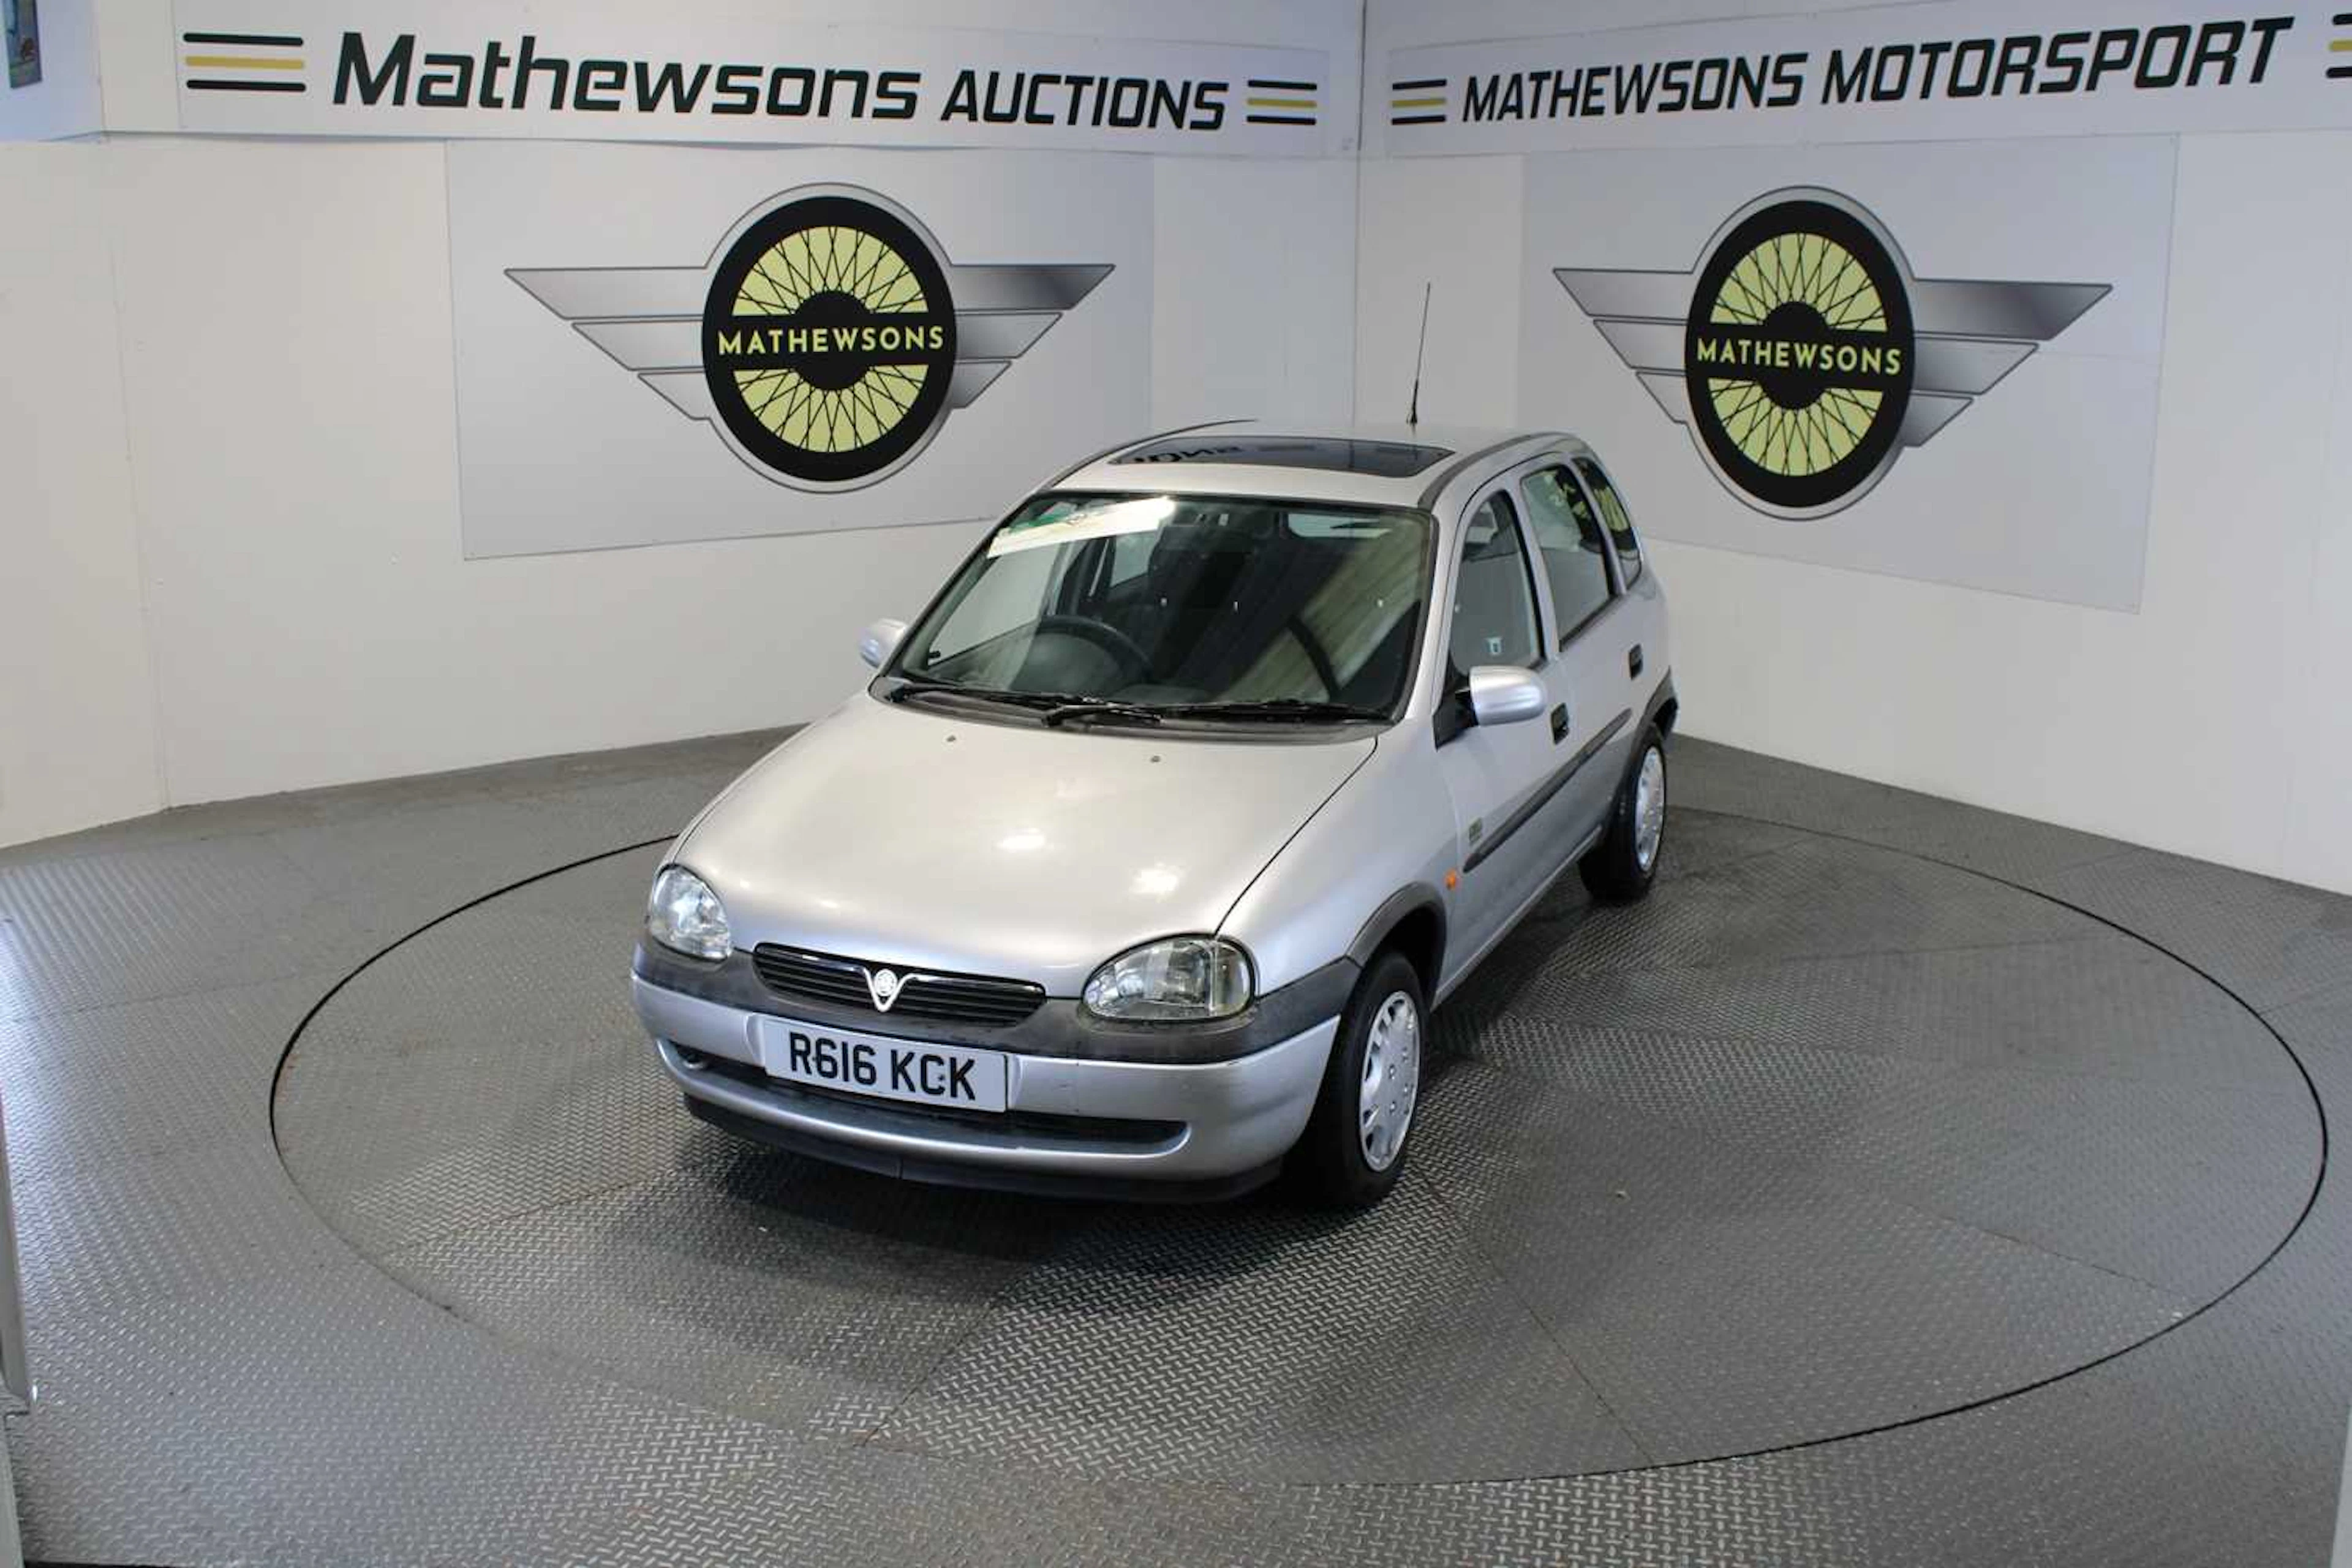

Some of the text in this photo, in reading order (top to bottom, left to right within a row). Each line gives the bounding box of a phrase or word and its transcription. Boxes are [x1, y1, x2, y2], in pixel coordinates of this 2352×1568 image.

[333, 31, 1230, 131] Mathewsons AUCTIONS
[1461, 16, 2296, 123] MATHEWSONS MOTORSPORT
[718, 325, 944, 355] MATHEWSONS
[1697, 337, 1902, 375] MATHEWSONS
[789, 1031, 976, 1101] R616 KCK
